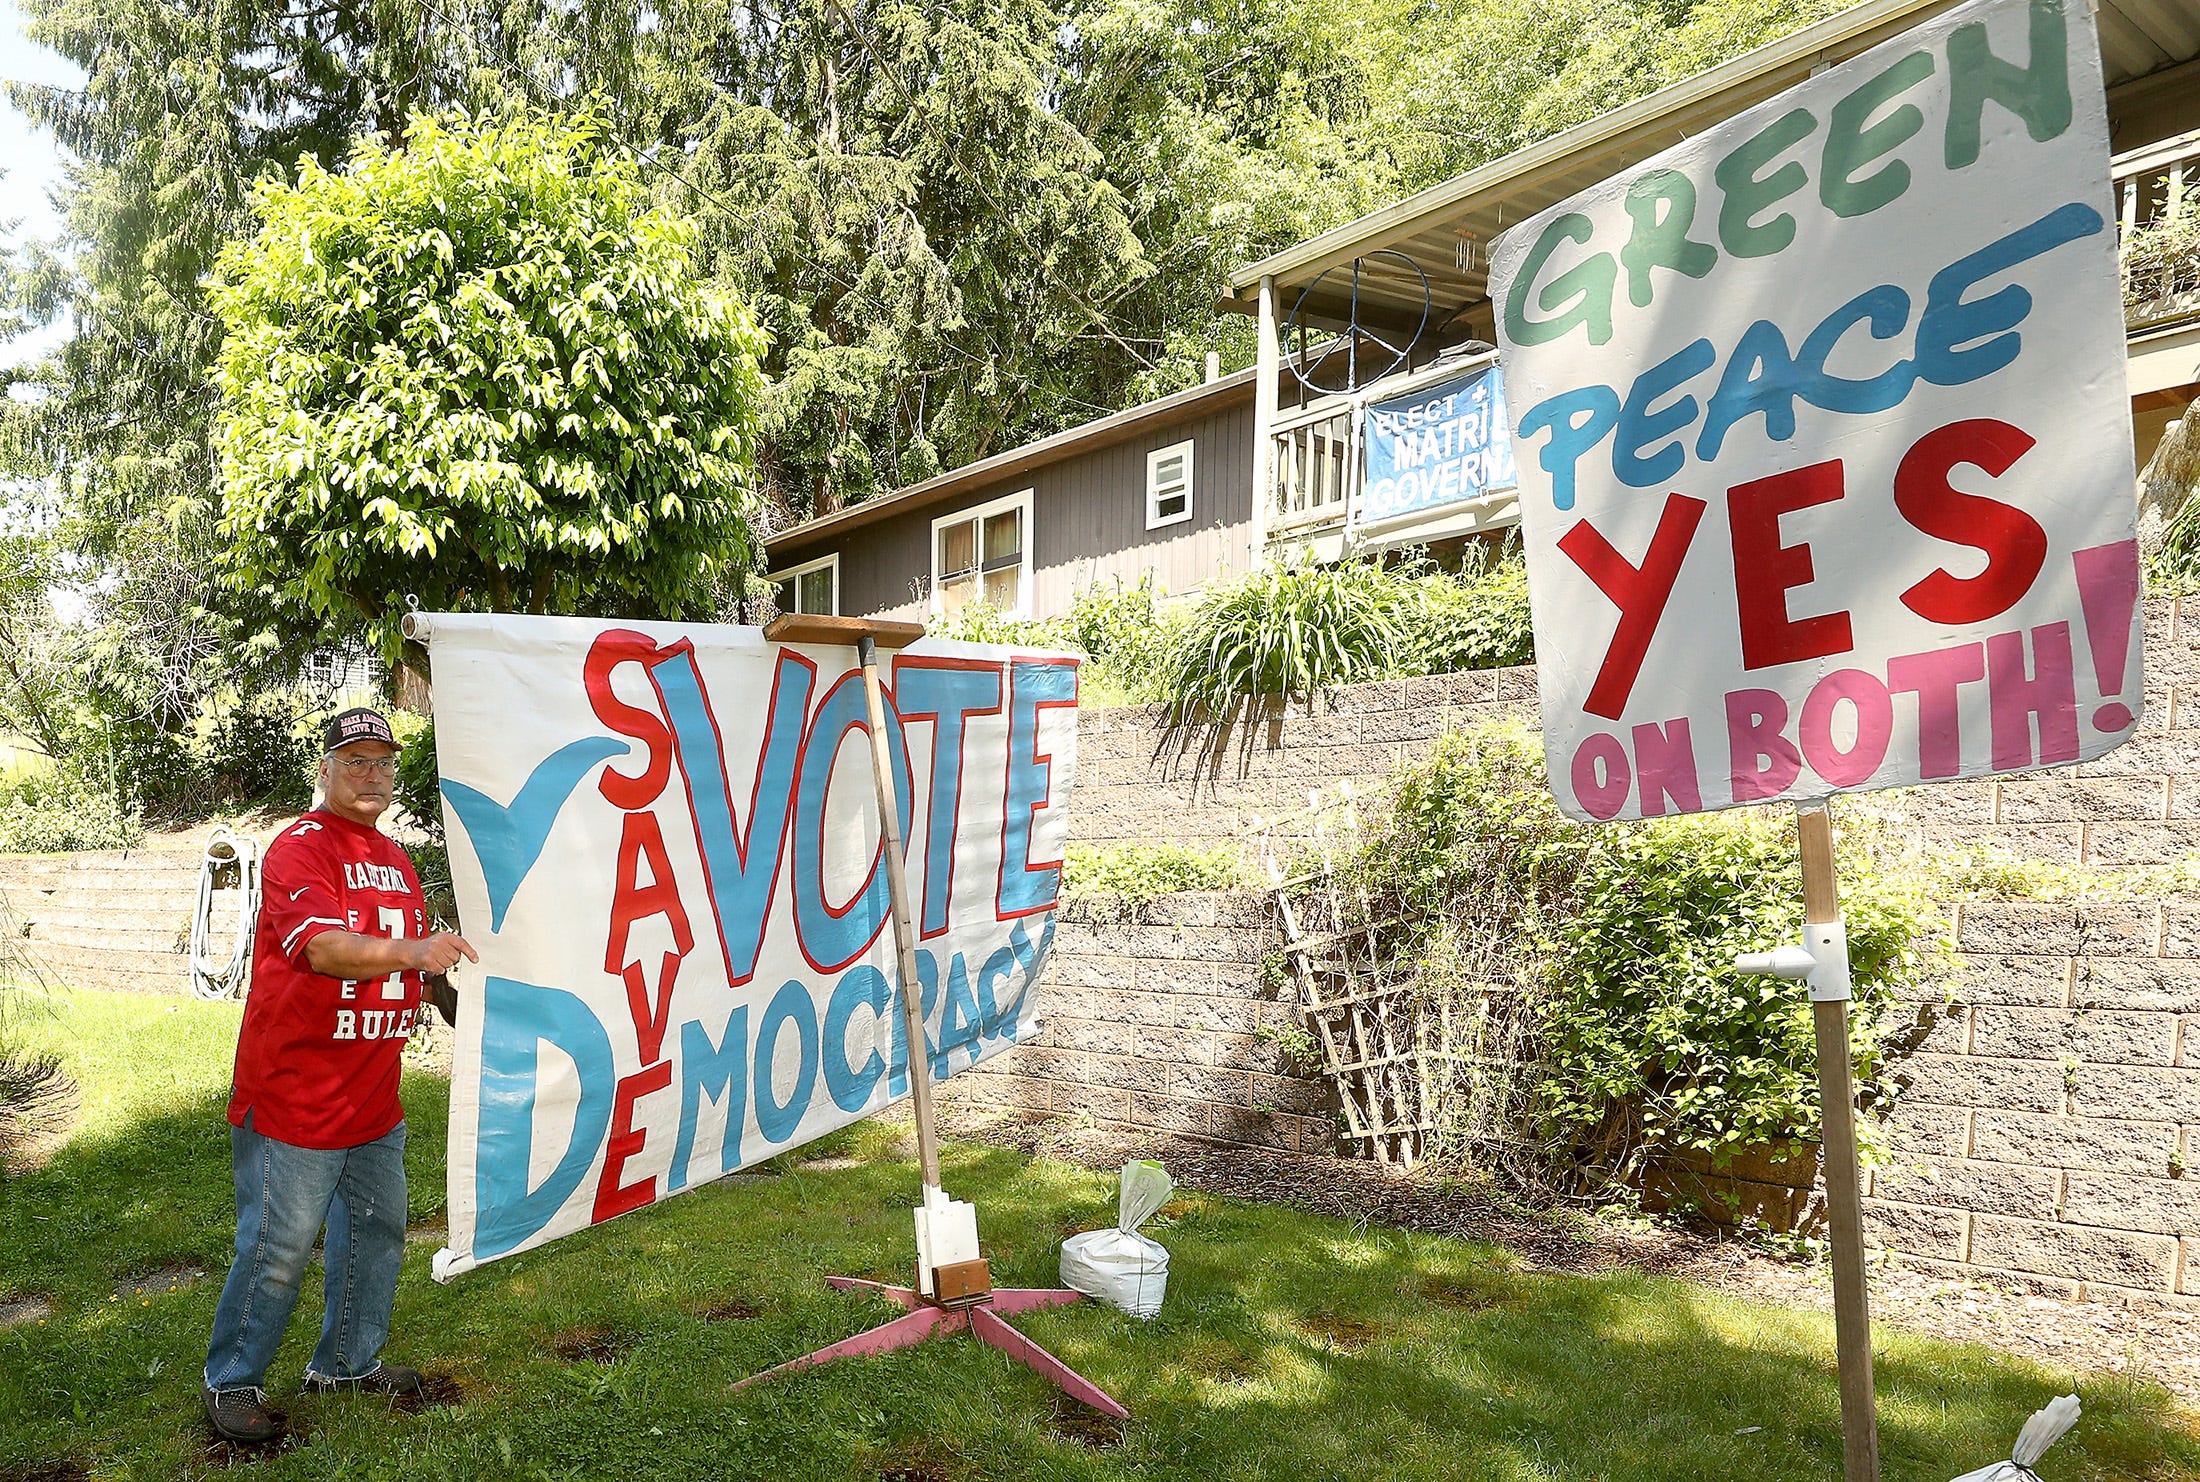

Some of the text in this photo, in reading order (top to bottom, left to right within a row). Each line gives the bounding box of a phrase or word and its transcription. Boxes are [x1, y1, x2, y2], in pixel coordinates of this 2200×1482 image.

[1504, 0, 2072, 346] GREEN
[1376, 393, 1459, 437] ELECT
[1519, 203, 2103, 511] PEACE
[1557, 418, 2048, 721] YES
[1570, 538, 2140, 820] ON BOTH!
[341, 723, 370, 737] NATIVE
[649, 635, 1079, 987] VOTE
[333, 1008, 419, 1040] RULE
[341, 909, 359, 999] FE
[377, 905, 406, 1000] 7
[583, 627, 694, 1225] SAVE
[474, 910, 1057, 1260] DEMOCRACY
